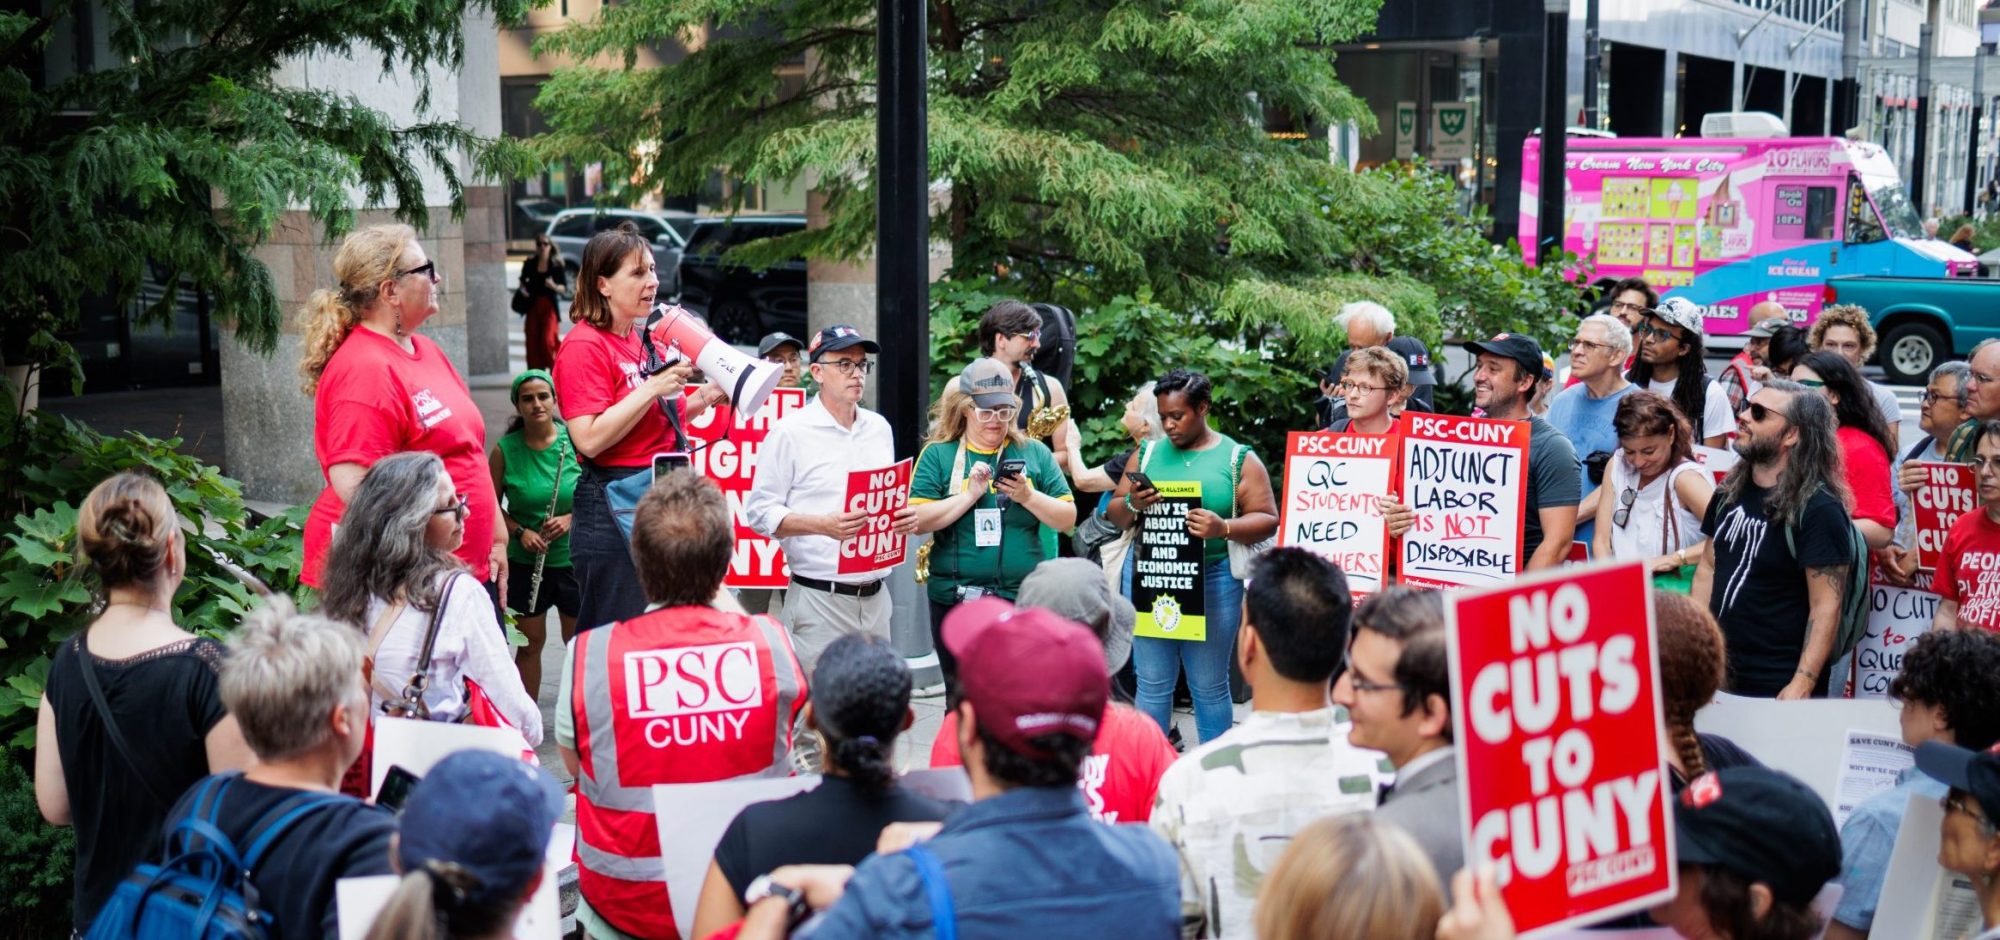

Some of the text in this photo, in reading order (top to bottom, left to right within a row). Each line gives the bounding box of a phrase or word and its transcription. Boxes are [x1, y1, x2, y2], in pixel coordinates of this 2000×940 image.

[1580, 155, 1621, 171] Cream
[1626, 156, 1656, 170] New
[1660, 157, 1692, 173] York
[1695, 158, 1727, 172] City
[1766, 151, 1830, 168] 10 FLAVORS
[1786, 266, 1820, 277] CREAM
[1412, 416, 1515, 443] PSC-CUNY
[1298, 435, 1387, 455] PSC-CUNY
[1307, 460, 1348, 489] QC
[1410, 443, 1514, 487] ADJUNCT
[1931, 467, 1959, 485] NO
[869, 470, 896, 490] NO
[849, 484, 906, 515] CUTS
[1173, 503, 1188, 515] IS
[1296, 490, 1384, 518] STUDENTS
[1414, 484, 1499, 514] LABOR
[1917, 486, 1973, 512] CUTS
[867, 514, 890, 533] TO
[1144, 517, 1185, 530] ABOUT
[1297, 521, 1358, 543] NEED
[1445, 512, 1492, 540] NOT
[840, 531, 904, 558] CUNY
[1142, 532, 1189, 545] RACIAL
[1151, 547, 1177, 559] AND
[1407, 541, 1515, 574] DISPOSABLE
[1137, 560, 1199, 575] ECONOMIC
[1141, 576, 1193, 589] JUSTICE
[1509, 583, 1590, 652] NO
[1893, 591, 1938, 620] CUT
[1882, 625, 1906, 648] to
[630, 647, 756, 712] PSC
[1469, 634, 1640, 744] CUTS
[645, 710, 750, 748] CUNY
[1521, 728, 1594, 796] TO
[1471, 770, 1660, 888] CUNY
